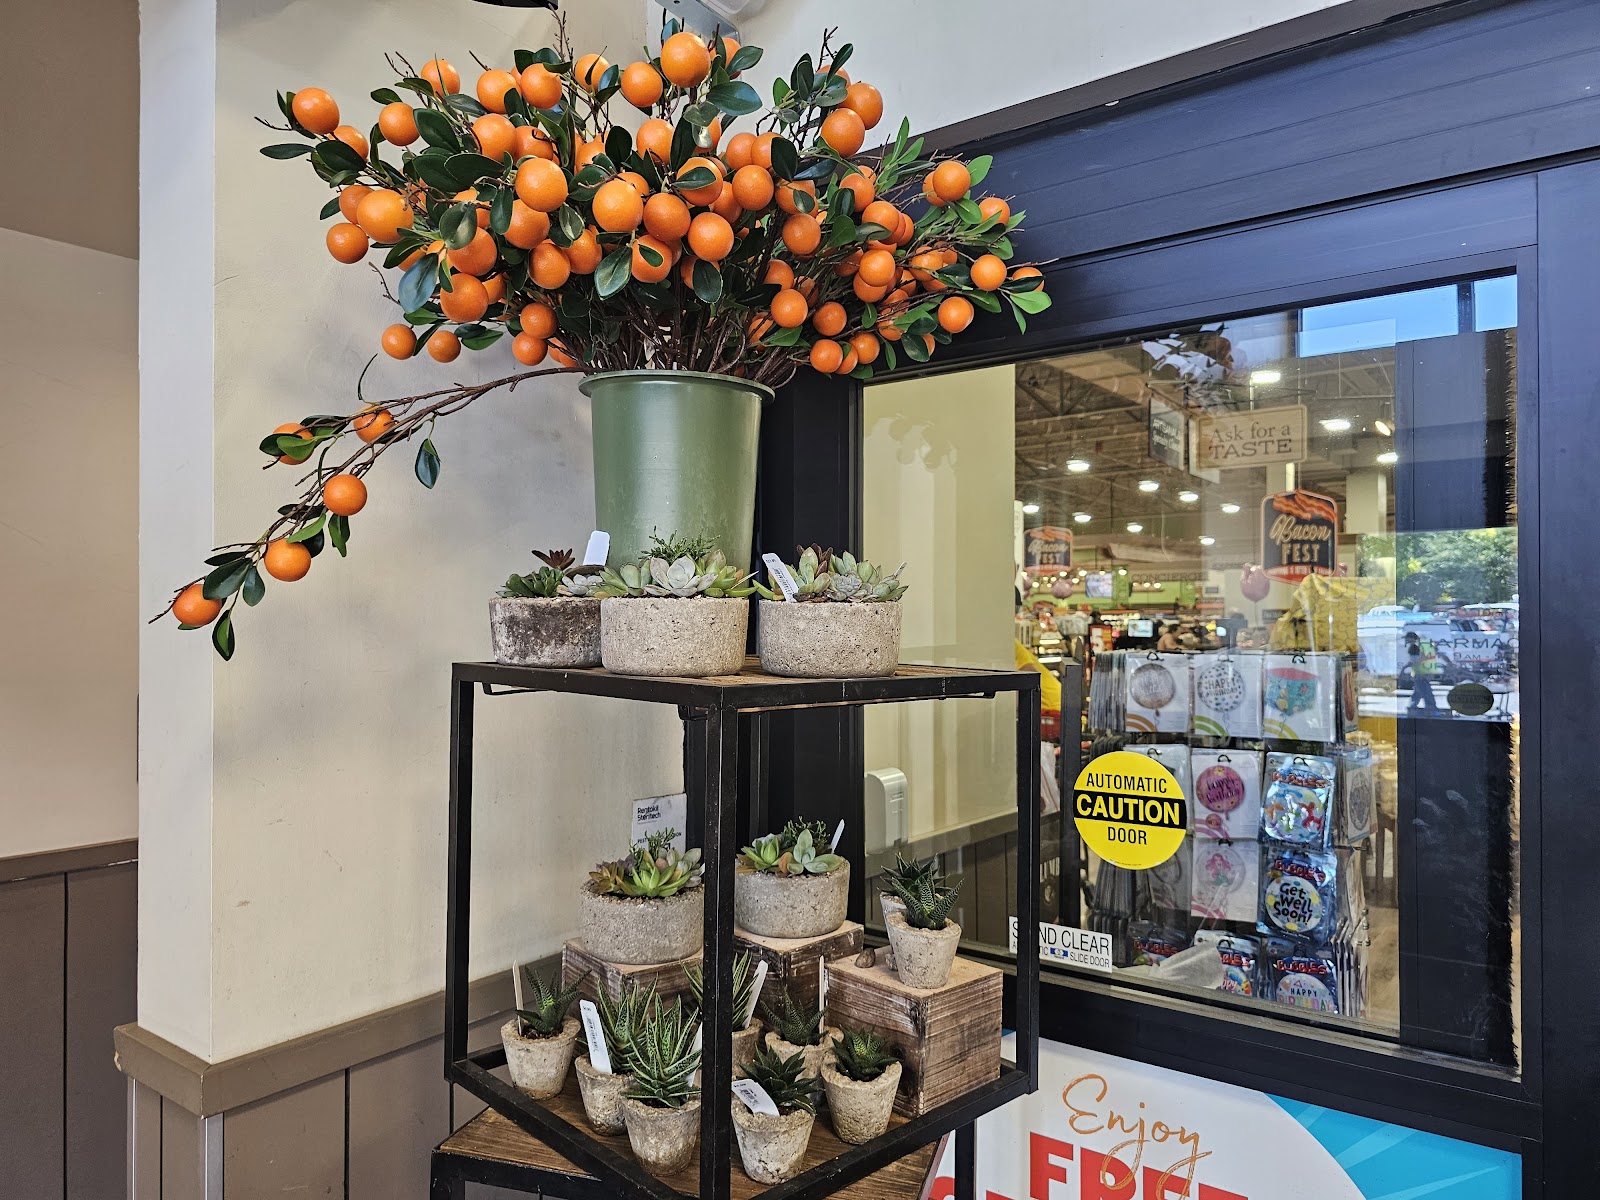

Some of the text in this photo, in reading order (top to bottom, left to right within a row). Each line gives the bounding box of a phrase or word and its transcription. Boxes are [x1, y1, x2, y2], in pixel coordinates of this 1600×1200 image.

[1209, 421, 1291, 443] Ask for a
[1209, 438, 1293, 460] TASTE
[1269, 513, 1331, 545] Bacon
[1028, 539, 1069, 556] Bacon
[1281, 543, 1320, 565] FEST
[1035, 552, 1061, 566] FEST
[1208, 678, 1236, 690] HAPPY
[1086, 772, 1167, 793] AUTOMATIC
[638, 813, 661, 821] Steritech
[1076, 793, 1180, 825] CAUTION
[1107, 826, 1147, 845] DOOR
[1280, 882, 1307, 899] Get
[1273, 901, 1313, 925] Soon!
[1061, 930, 1110, 957] CLEAR
[1089, 955, 1110, 968] DOOR
[1290, 988, 1317, 997] HAPPY
[1062, 1073, 1213, 1200] Enjoy
[1029, 1131, 1249, 1200] FR
